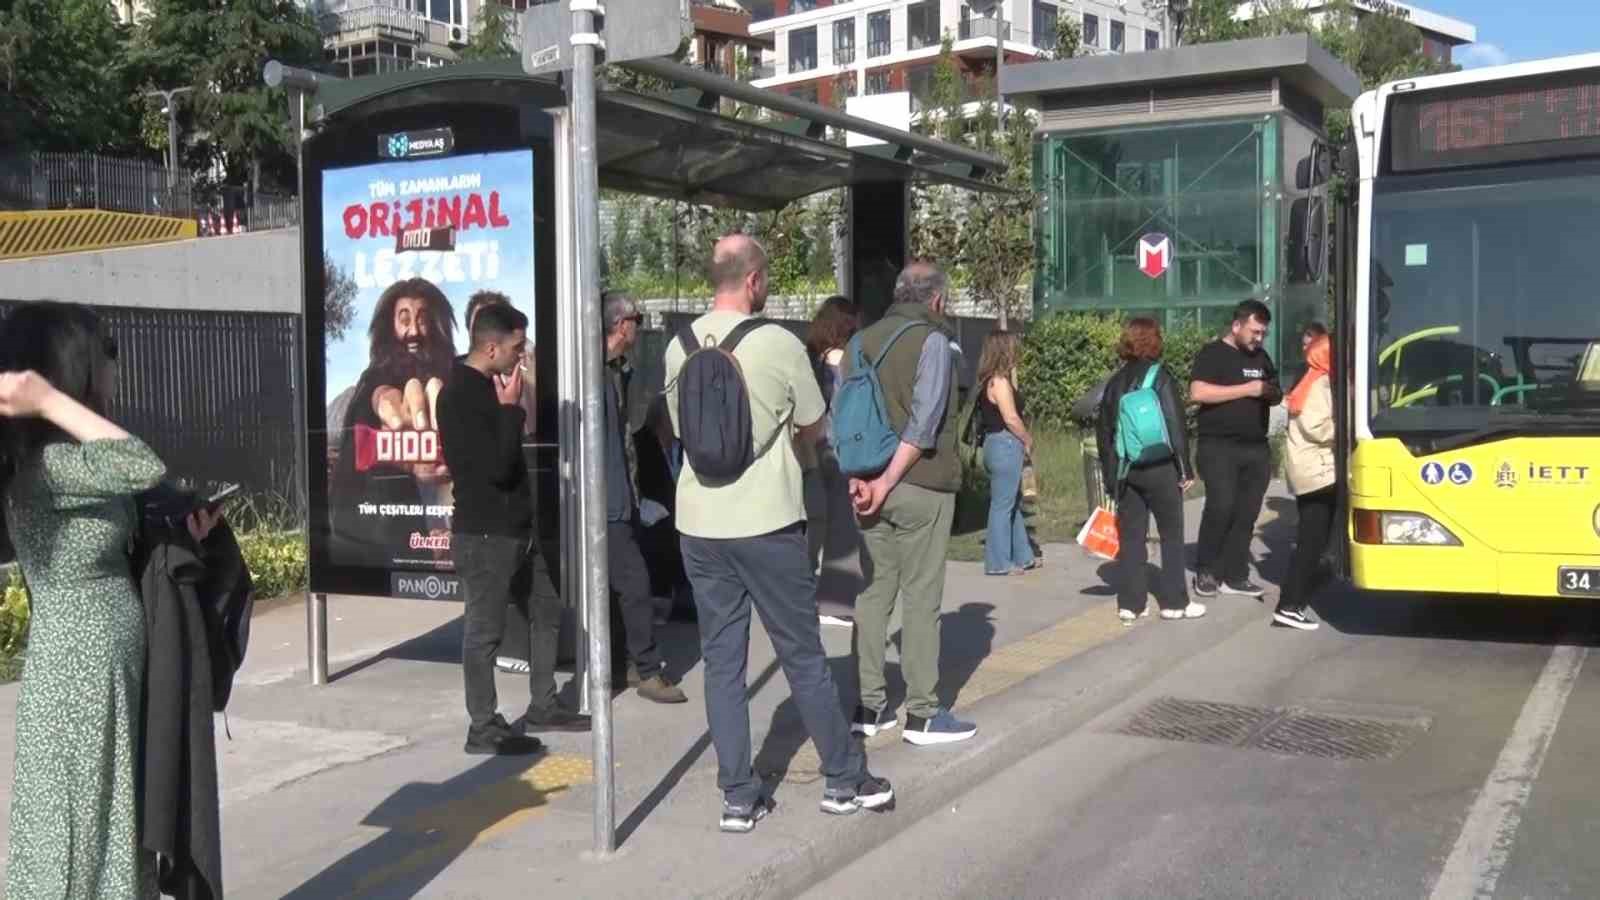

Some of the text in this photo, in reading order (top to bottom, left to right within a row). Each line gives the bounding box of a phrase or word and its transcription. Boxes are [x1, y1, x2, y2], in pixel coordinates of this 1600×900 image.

[368, 179, 396, 198] TÜM
[355, 240, 499, 288] LEZZETİ
[358, 502, 377, 515] TÜM
[410, 532, 450, 549] ÜLKER
[398, 576, 459, 598] PANOUT
[1566, 571, 1591, 590] 34
